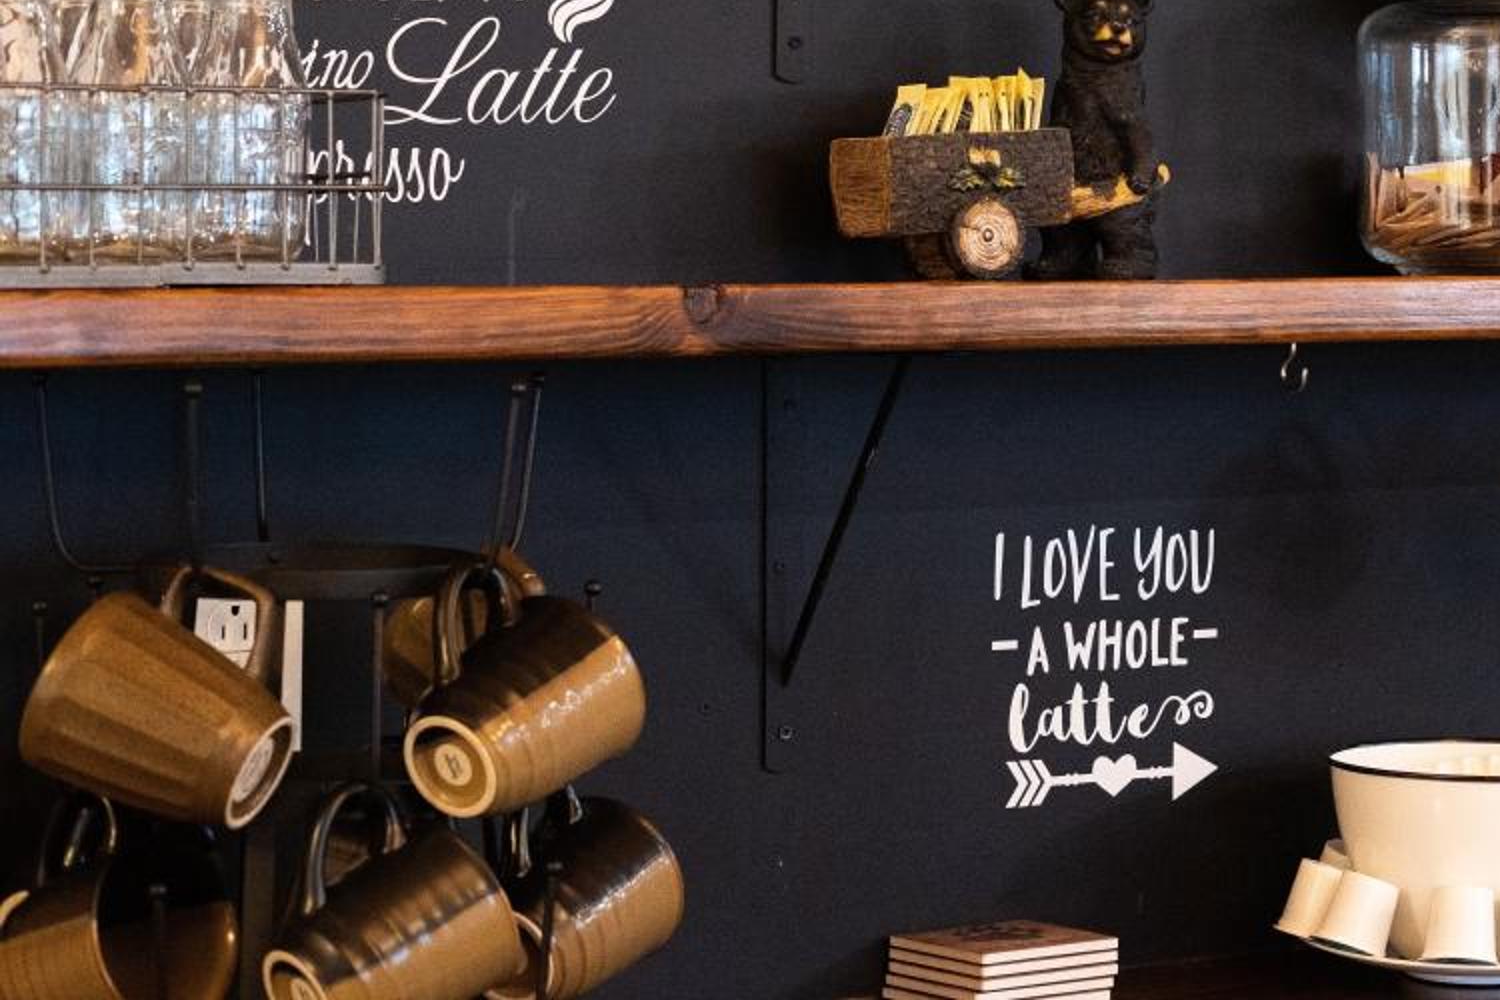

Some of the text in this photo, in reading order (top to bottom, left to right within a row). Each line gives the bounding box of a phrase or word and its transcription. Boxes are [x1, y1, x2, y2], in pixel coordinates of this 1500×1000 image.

[384, 17, 618, 125] Latte
[993, 524, 1216, 610] I LOVE YOU
[1008, 680, 1215, 754] latte
